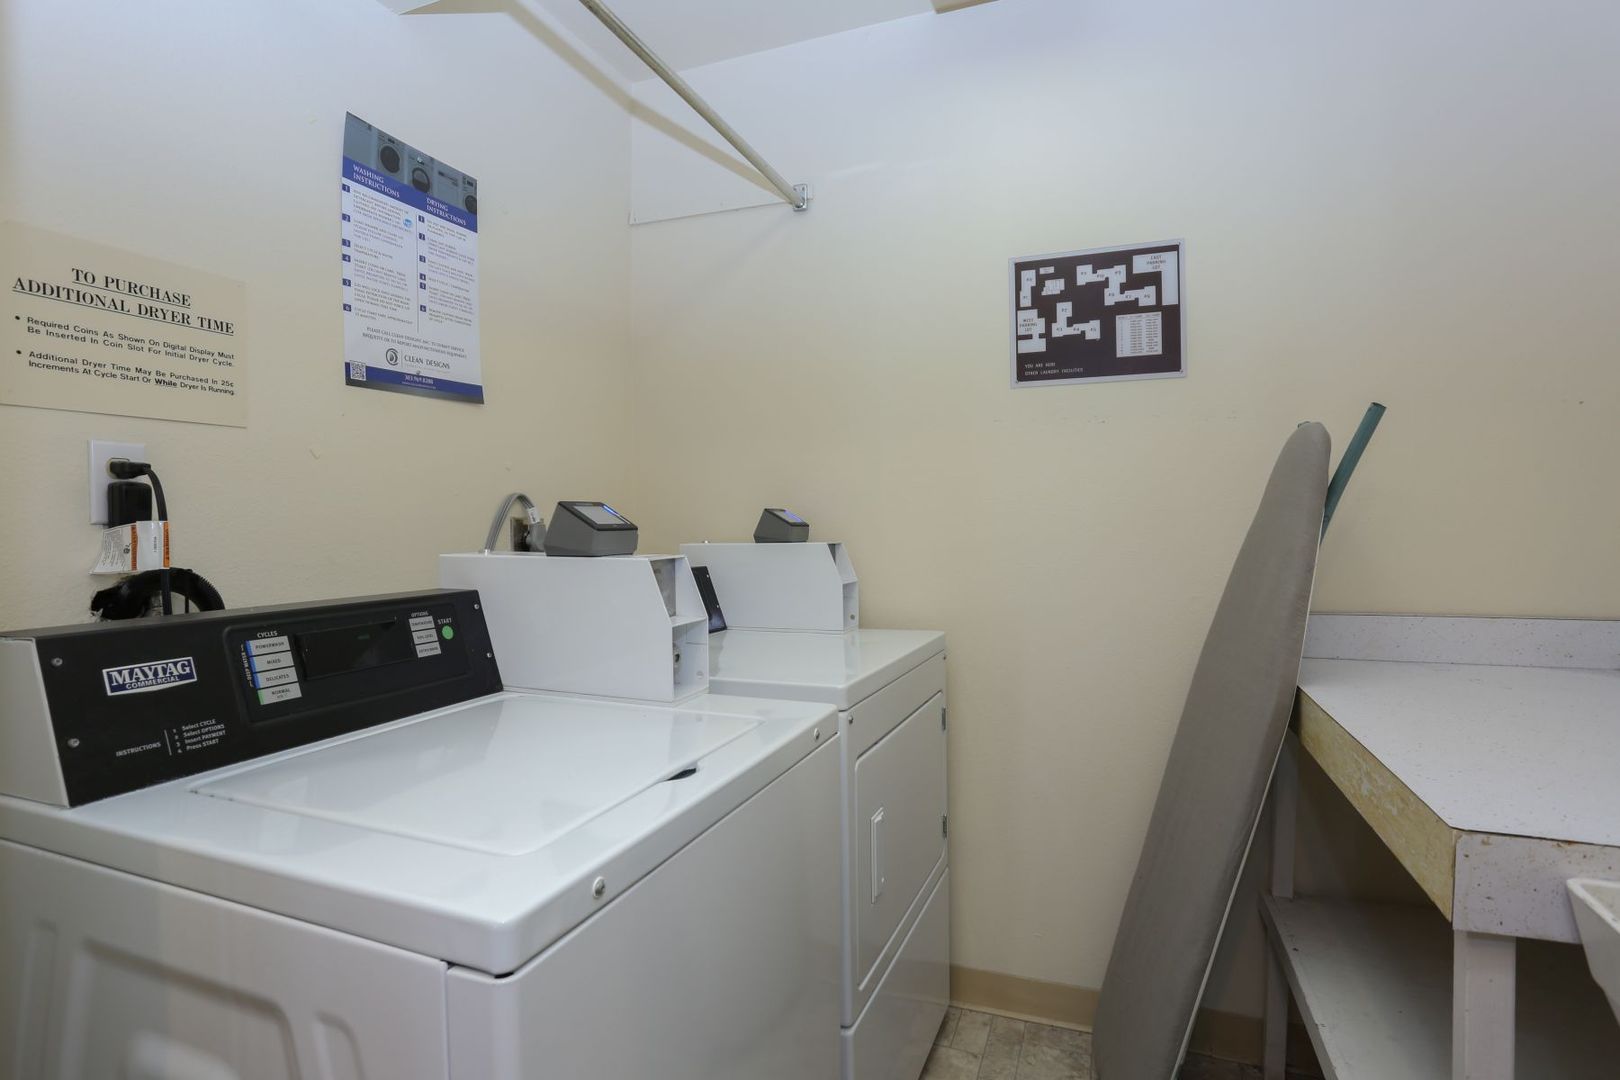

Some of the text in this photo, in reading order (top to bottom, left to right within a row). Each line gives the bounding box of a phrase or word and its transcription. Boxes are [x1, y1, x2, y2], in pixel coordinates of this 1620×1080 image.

[353, 164, 384, 183] WASHING
[353, 172, 400, 198] INSTRUCTIONS
[426, 197, 448, 211] DRYING
[426, 205, 466, 226] INSTRUCTIONS
[72, 268, 191, 307] TO PURCHASE
[12, 277, 234, 334] ADDITIONAL DRYER TIME
[27, 316, 234, 360] Required Coins As Shown On Digital Display Must
[27, 326, 41, 335] Be
[45, 329, 86, 343] Inserted
[90, 337, 99, 345] In
[103, 339, 123, 349] Coin
[127, 343, 144, 353] Slot
[148, 347, 162, 355] For
[164, 350, 186, 360] Initial
[189, 354, 209, 363] Dryer
[29, 351, 78, 365] Additional
[81, 358, 107, 369] Dryer
[111, 362, 131, 373] Time
[135, 367, 152, 377] May
[155, 370, 167, 378] Be
[169, 372, 209, 384] Purchased
[404, 354, 424, 365] CLEAN
[425, 359, 450, 369] DESIGNS
[28, 360, 80, 374] Increments
[93, 369, 118, 379] Cycle
[120, 373, 140, 381] Start
[154, 378, 178, 387] While
[180, 381, 199, 390] Dryer
[200, 384, 207, 392] Is
[437, 617, 452, 625] START
[256, 630, 278, 638] CYCLES
[108, 660, 191, 686] MAYTAG
[265, 673, 290, 682] DELICATES
[125, 675, 181, 690] COMMERCIAL
[182, 722, 199, 731] Select
[199, 718, 216, 727] CYCLE
[183, 729, 200, 738] Select
[201, 724, 225, 734] OPTIONS
[184, 736, 201, 744] Insert
[201, 730, 226, 740] PAYMENT
[186, 743, 202, 751] Press
[202, 738, 219, 747] START
[115, 741, 161, 757] INSTRUCTIONS
